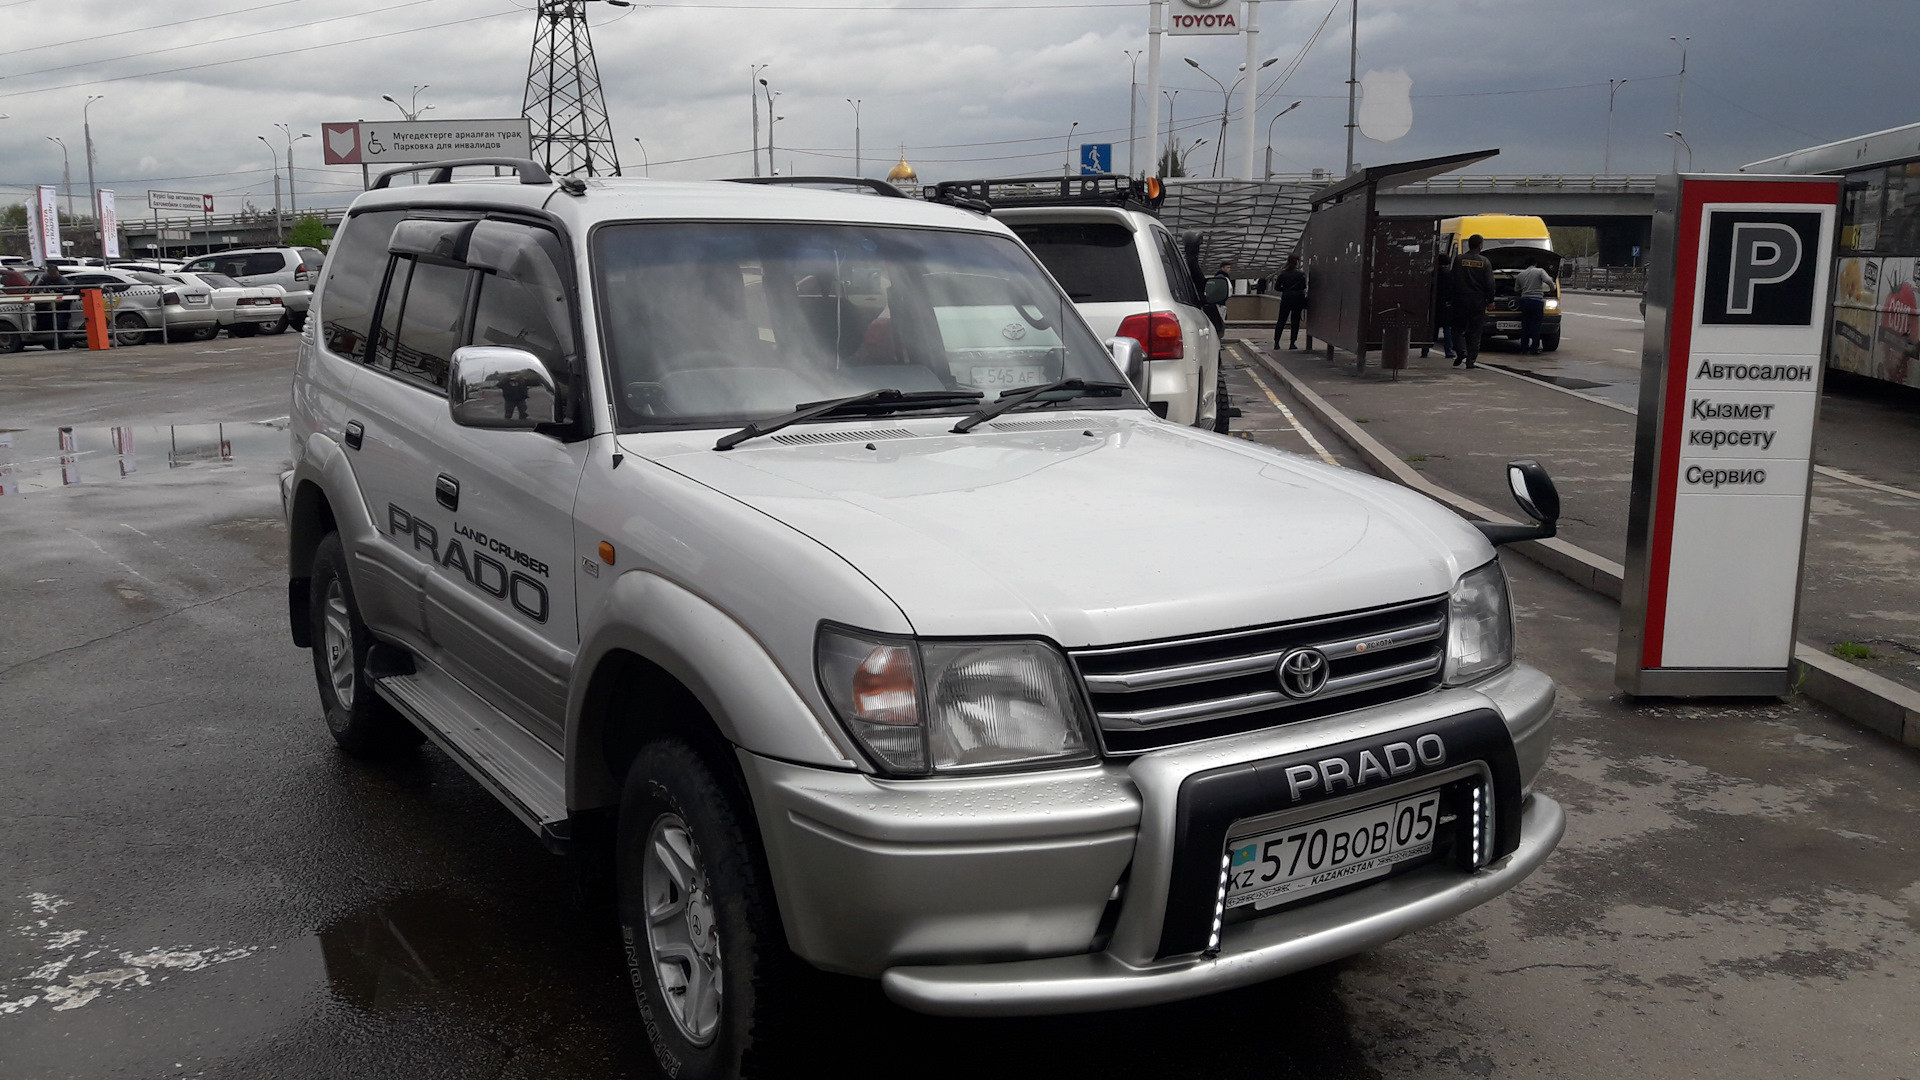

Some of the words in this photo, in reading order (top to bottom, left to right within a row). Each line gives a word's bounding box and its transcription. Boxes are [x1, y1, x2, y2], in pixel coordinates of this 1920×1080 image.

[1172, 14, 1236, 28] TOYOTA
[393, 132, 452, 141] Мүгедектерге
[455, 131, 495, 140] арналған
[393, 142, 434, 152] Парковка
[436, 142, 452, 151] для
[454, 141, 501, 150] инвалидов
[1726, 222, 1803, 315] P
[987, 369, 1014, 383] 545
[1695, 359, 1813, 381] Автосалон
[1691, 398, 1775, 420] Қызмет
[1688, 429, 1777, 450] көрсету
[1684, 464, 1767, 489] Сервис
[454, 522, 488, 547] LAND
[489, 539, 550, 578] CRUISER
[388, 501, 550, 625] PRADO
[1285, 733, 1447, 802] PRADO
[1228, 869, 1254, 892] KZ
[1396, 800, 1435, 846] 05
[1310, 860, 1375, 886] KAZAKHSTAN
